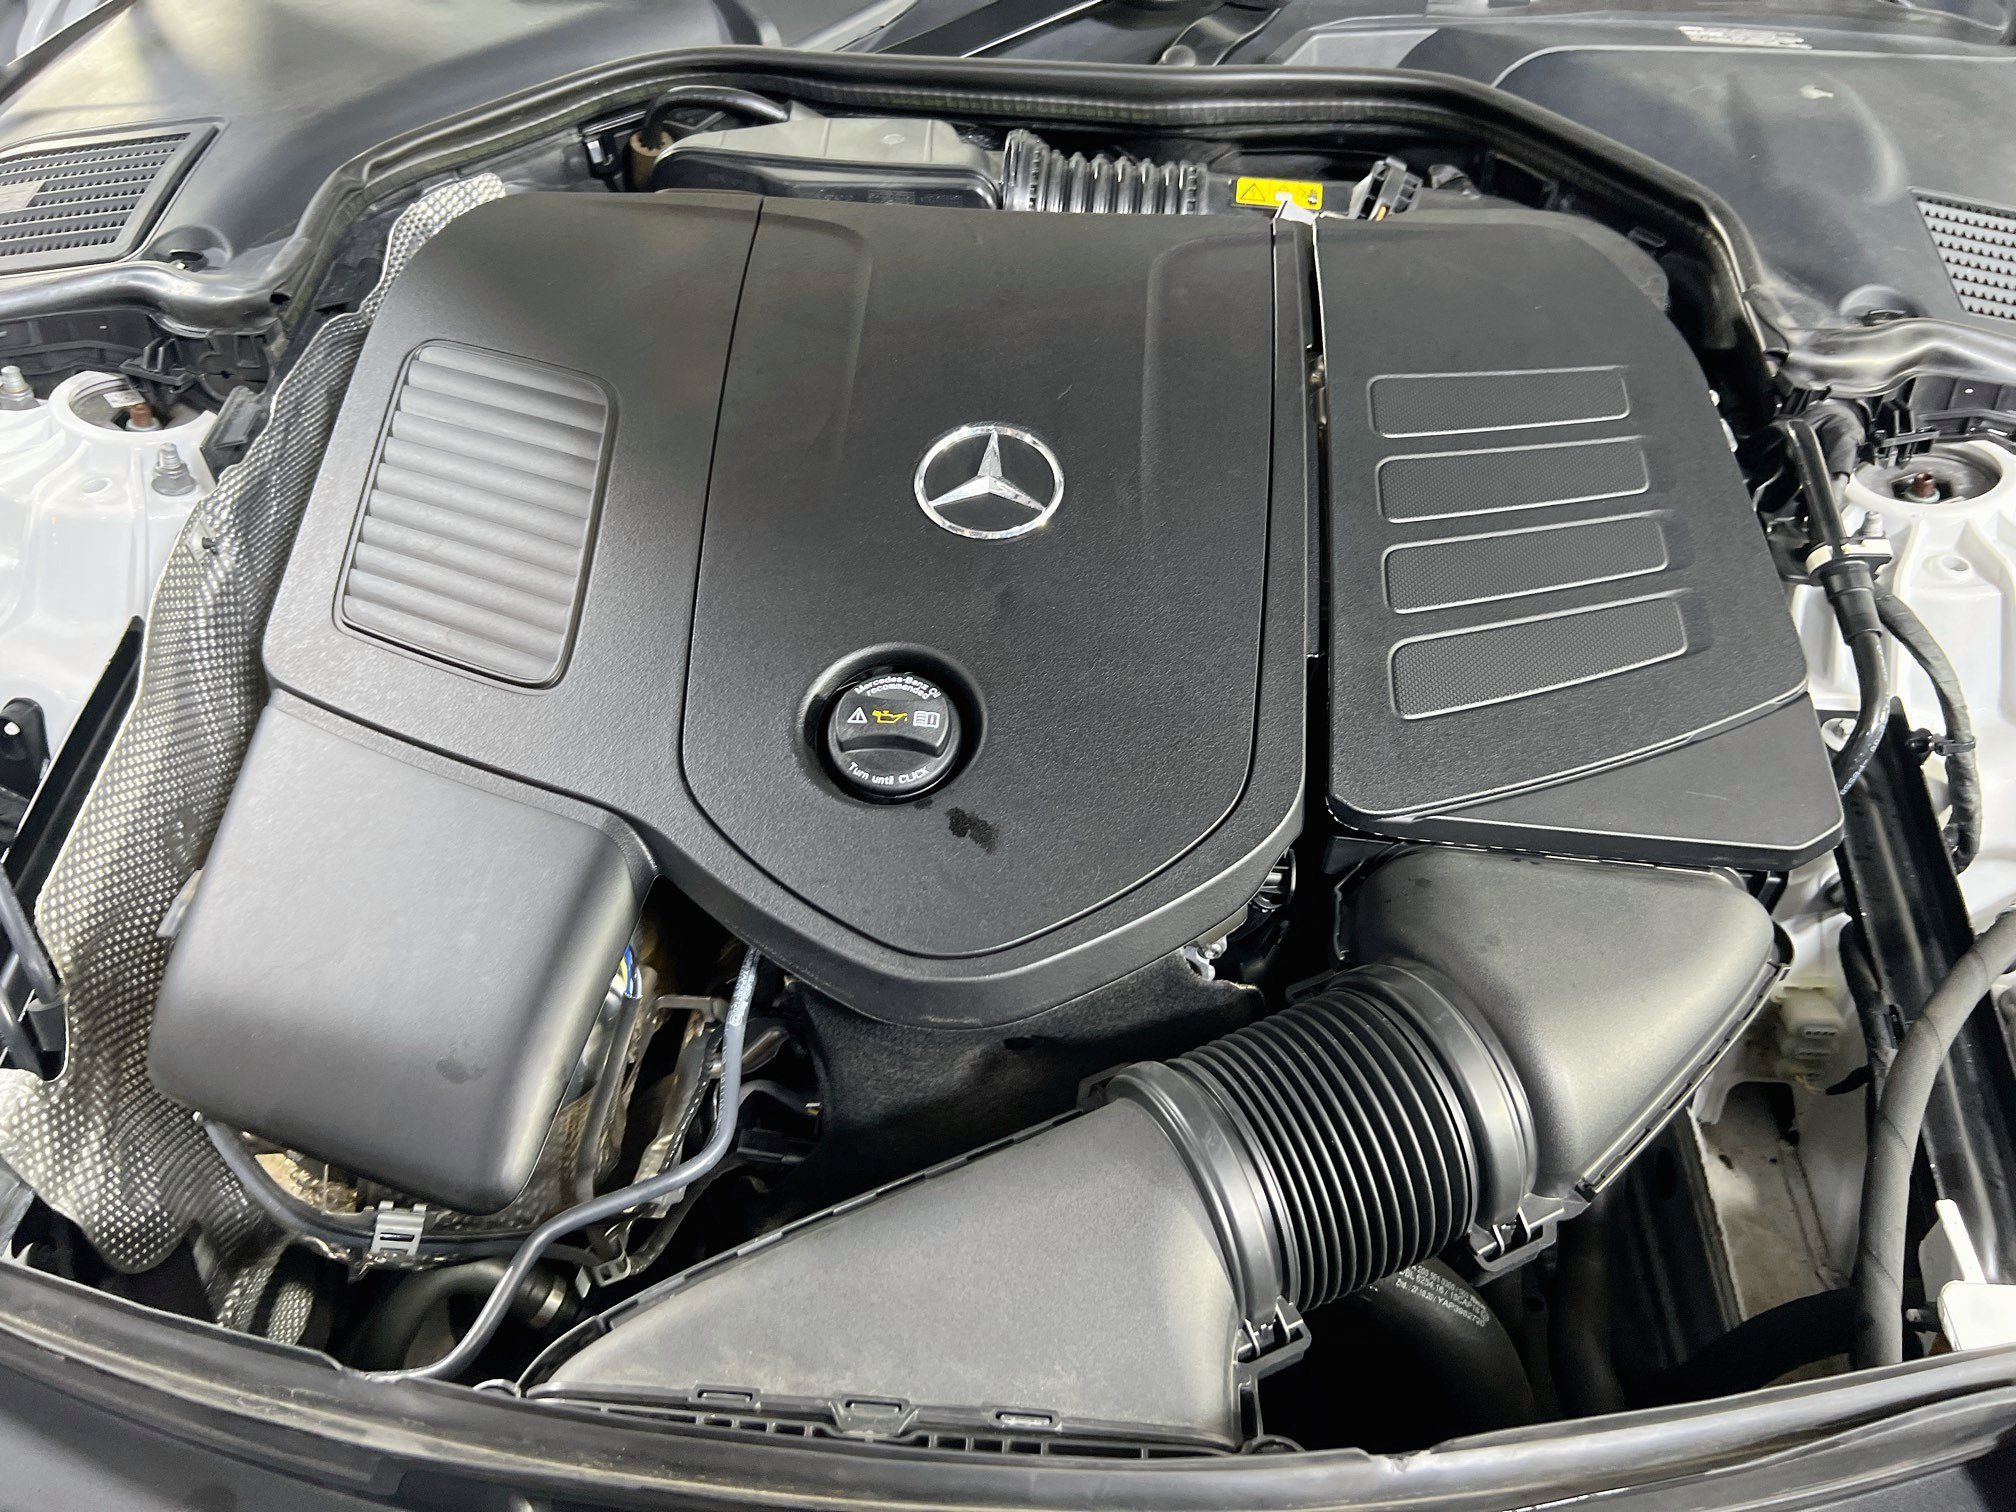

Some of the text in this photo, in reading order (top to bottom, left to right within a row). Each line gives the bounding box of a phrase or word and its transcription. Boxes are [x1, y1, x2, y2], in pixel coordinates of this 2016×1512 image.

[854, 675, 942, 699] Mercedes-Benz Oil
[866, 683, 931, 700] recommended
[848, 761, 930, 785] Turn until CLICK
